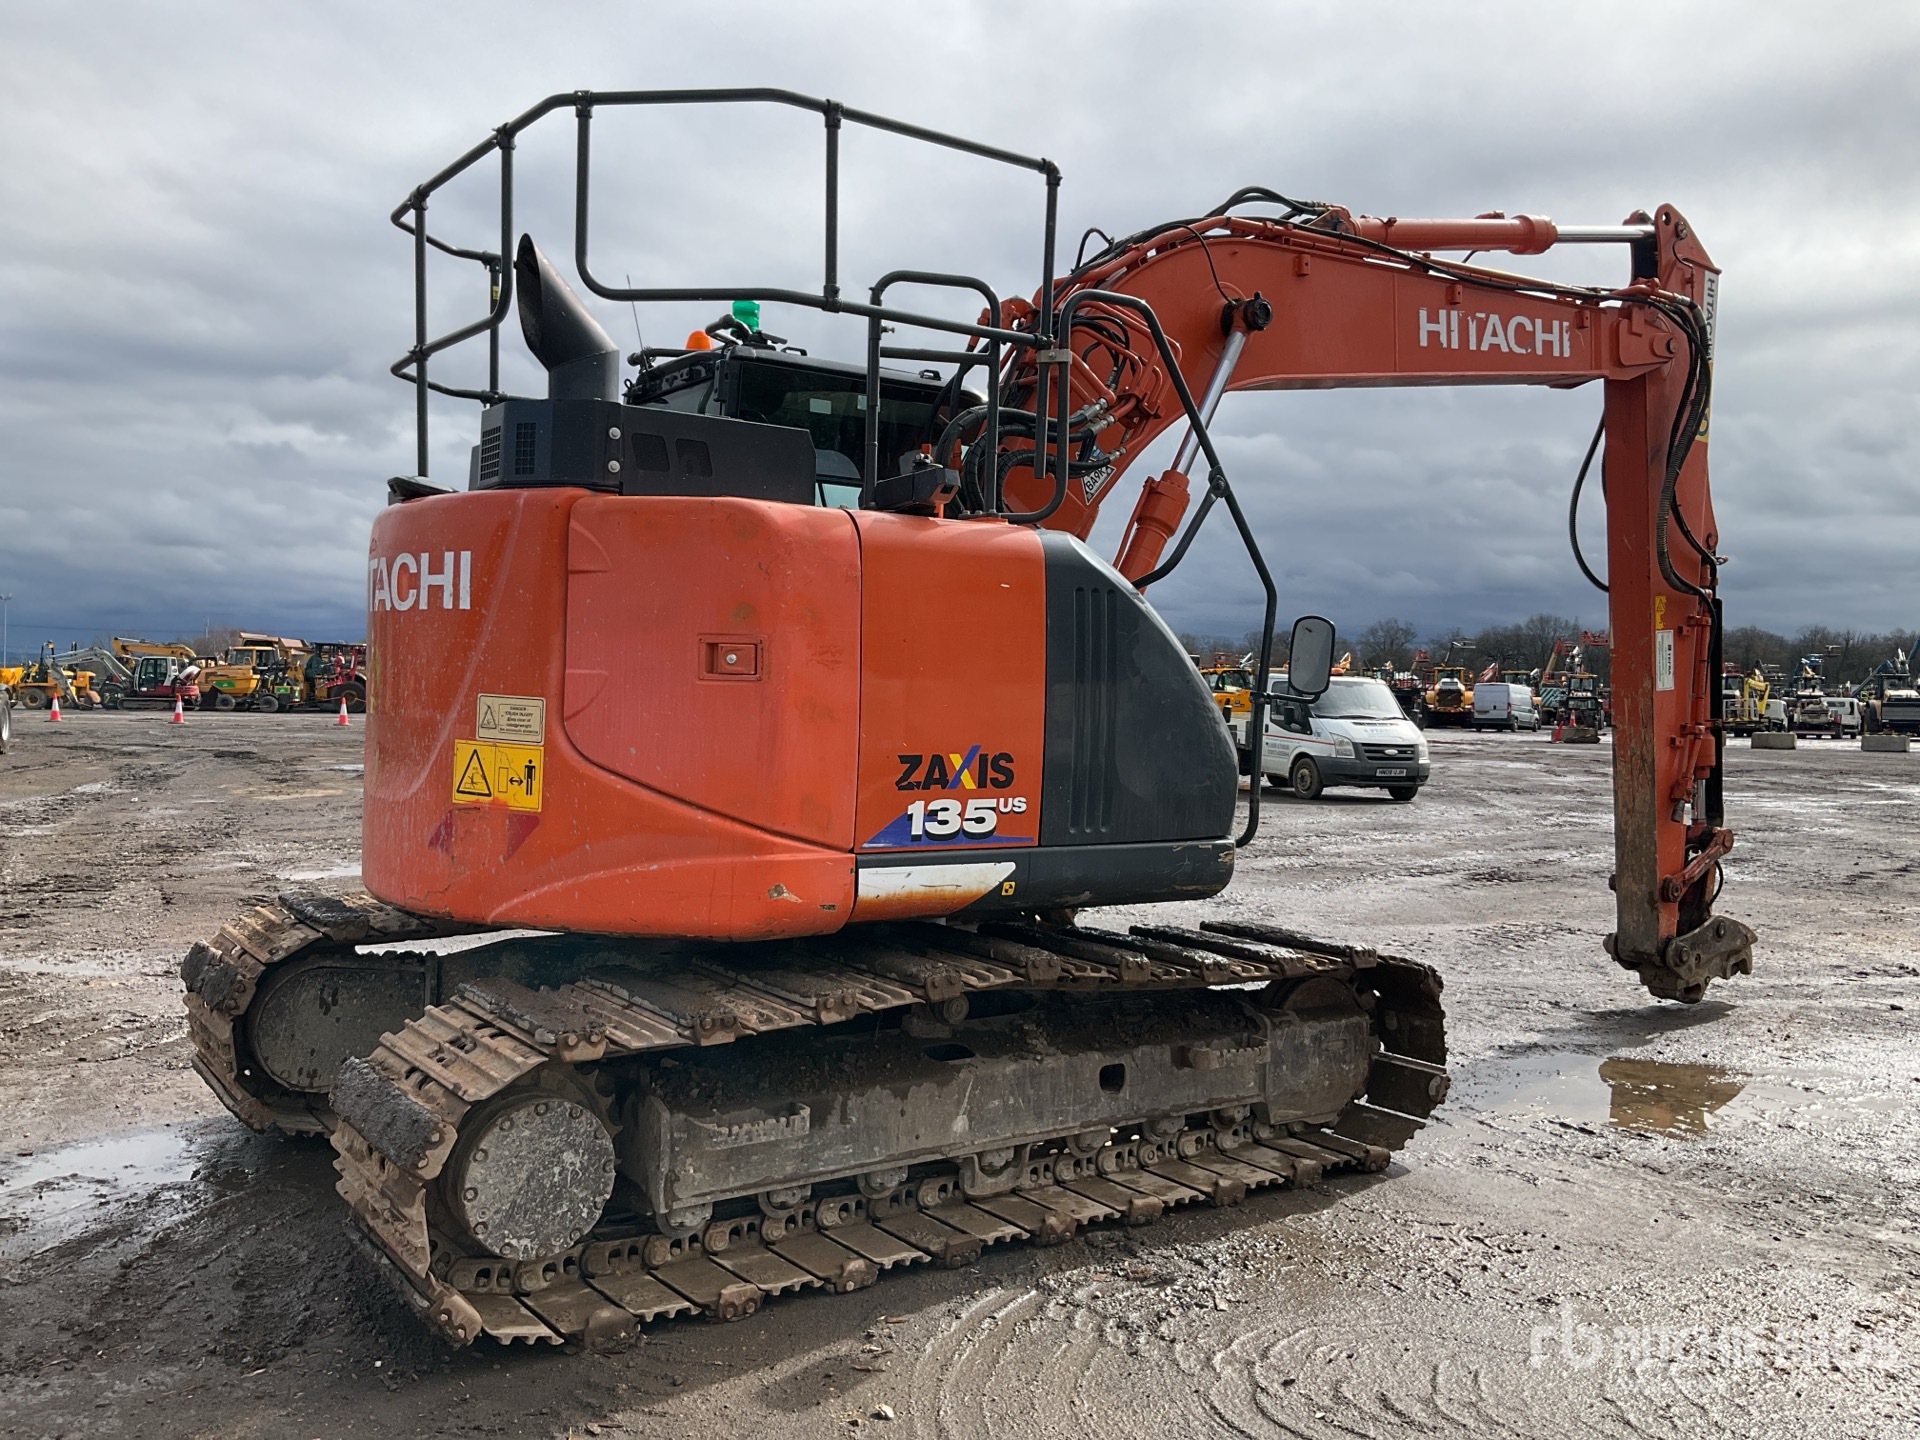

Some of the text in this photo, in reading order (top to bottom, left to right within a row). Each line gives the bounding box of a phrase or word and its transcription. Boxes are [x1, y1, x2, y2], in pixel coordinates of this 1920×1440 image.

[1419, 307, 1571, 358] HITACHI
[895, 744, 1015, 790] ZAXIS
[907, 797, 1027, 841] 135 US
